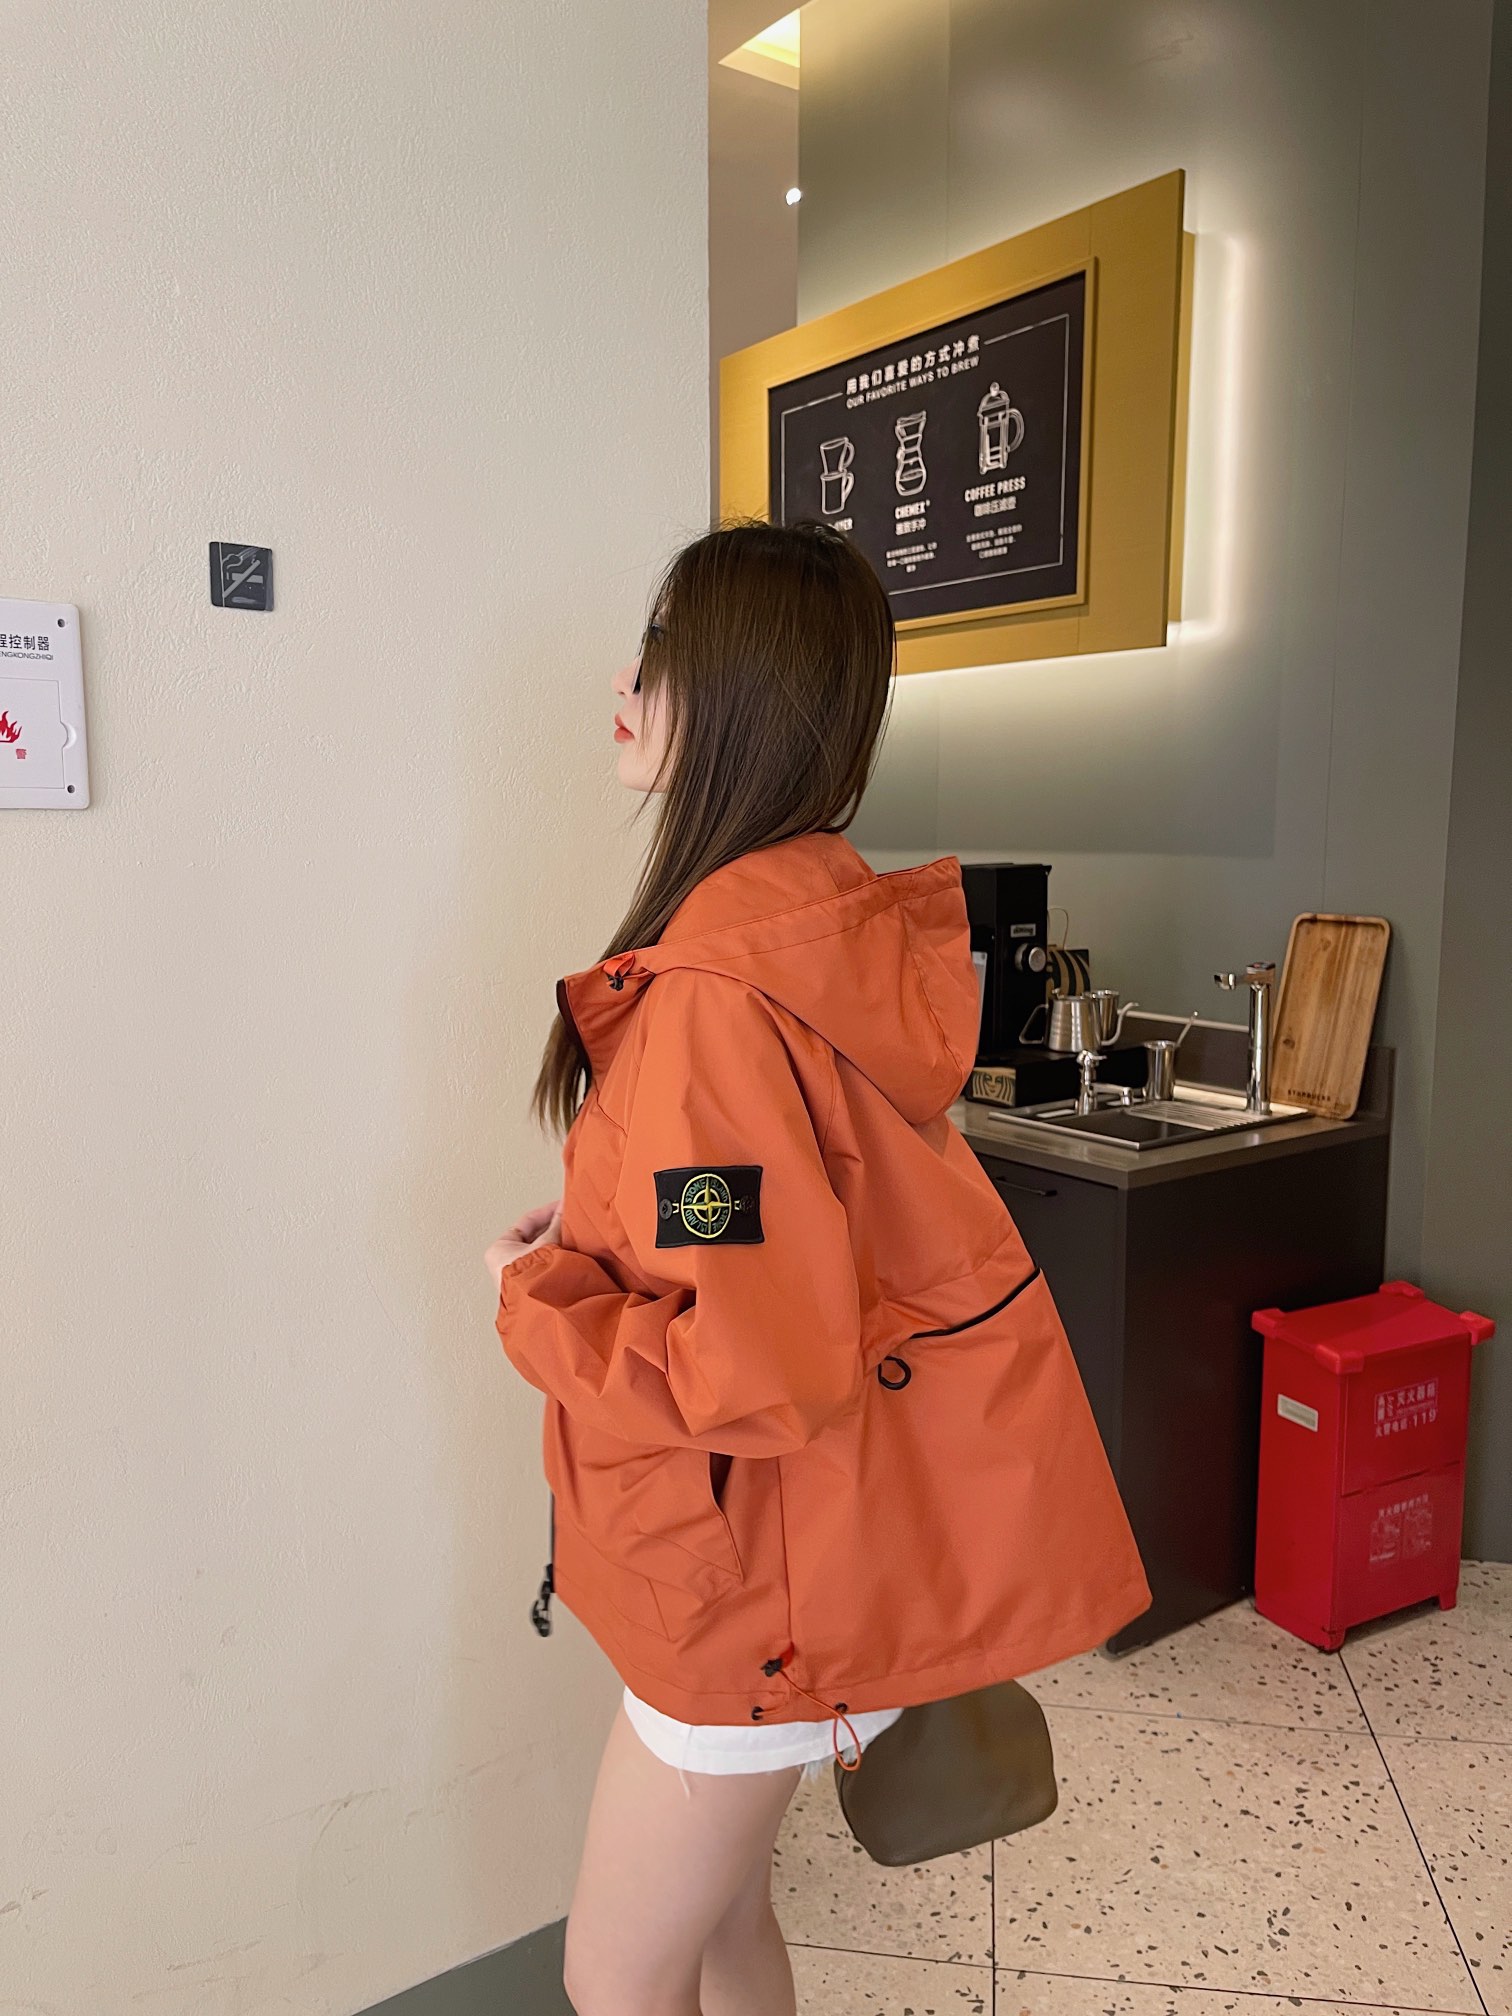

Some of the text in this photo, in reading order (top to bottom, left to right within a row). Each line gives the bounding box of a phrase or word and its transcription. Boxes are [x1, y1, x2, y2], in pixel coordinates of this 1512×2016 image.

[846, 334, 980, 395] 用我们喜爱的方式冲煮
[846, 355, 980, 409] OUR FAVORITE WAYS TO BREW
[964, 476, 1026, 502] COFFEE PRESS
[685, 1178, 728, 1203] STONE ISLAND
[685, 1209, 708, 1234] ISLAND
